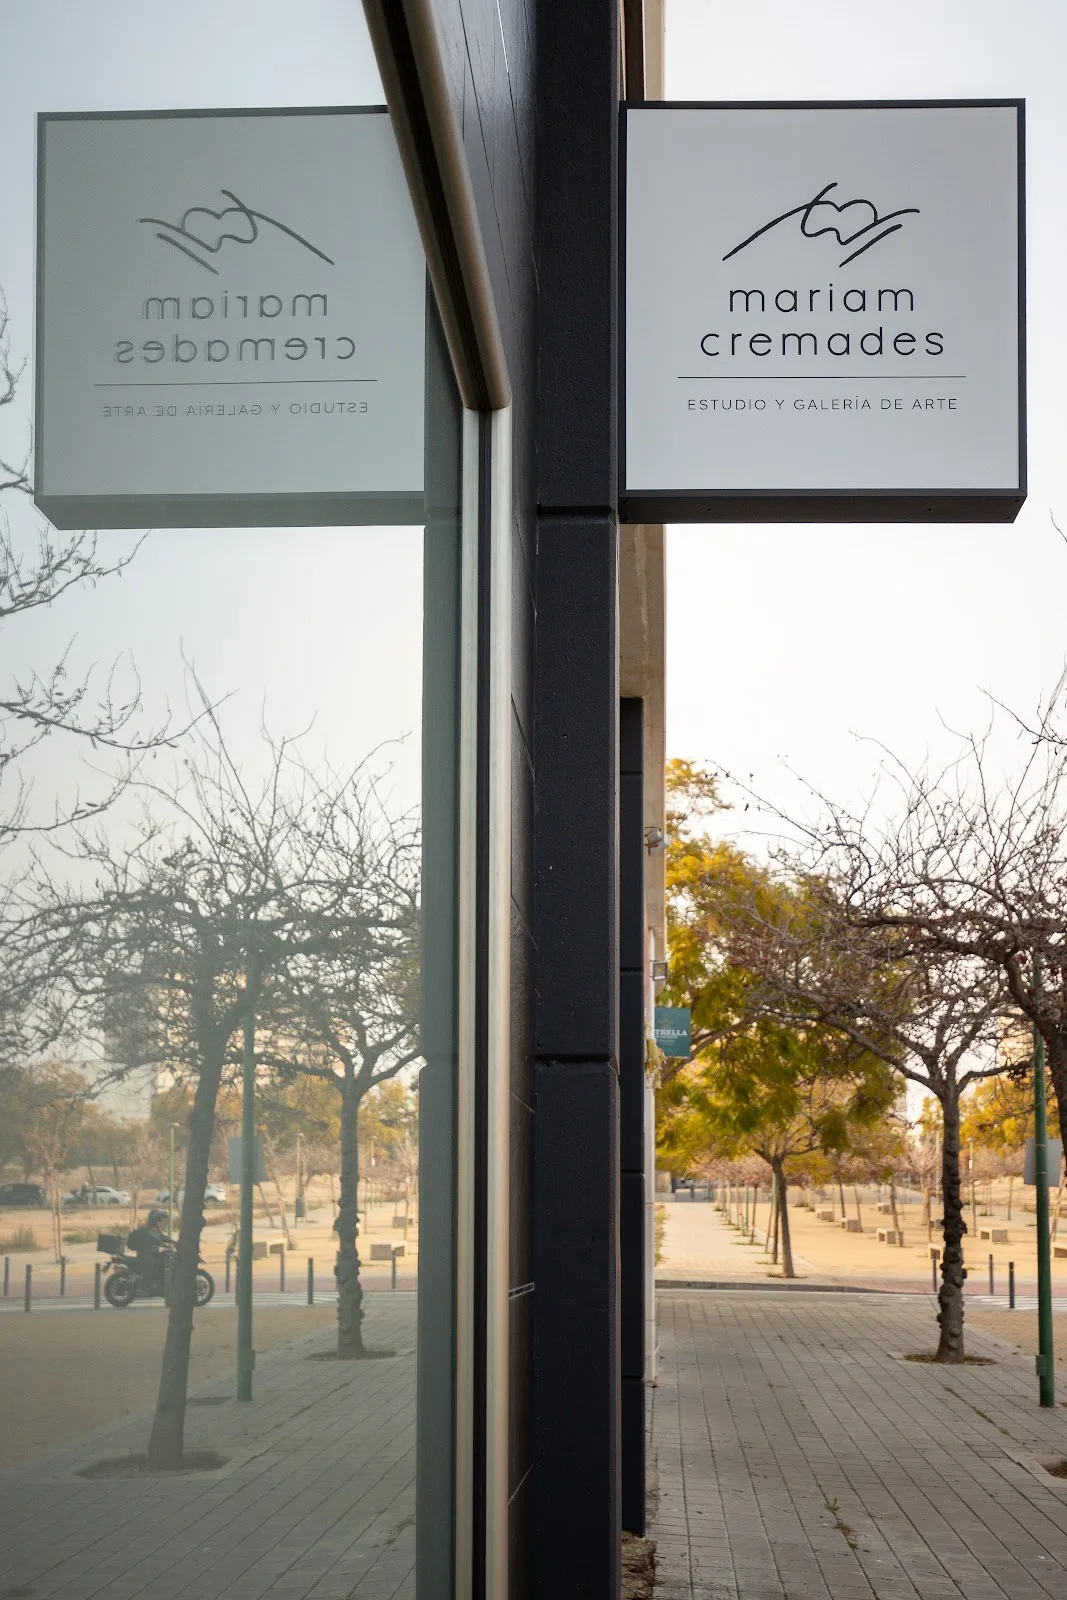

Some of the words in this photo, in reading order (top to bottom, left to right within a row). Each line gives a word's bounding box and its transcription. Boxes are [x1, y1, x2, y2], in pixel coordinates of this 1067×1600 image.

[729, 282, 914, 313] mariam
[700, 326, 944, 357] cremades
[687, 398, 767, 411] ESTUDIO
[774, 399, 785, 411] Y
[793, 395, 872, 411] GALERÍA
[880, 398, 903, 410] DE
[911, 398, 957, 410] ARTE
